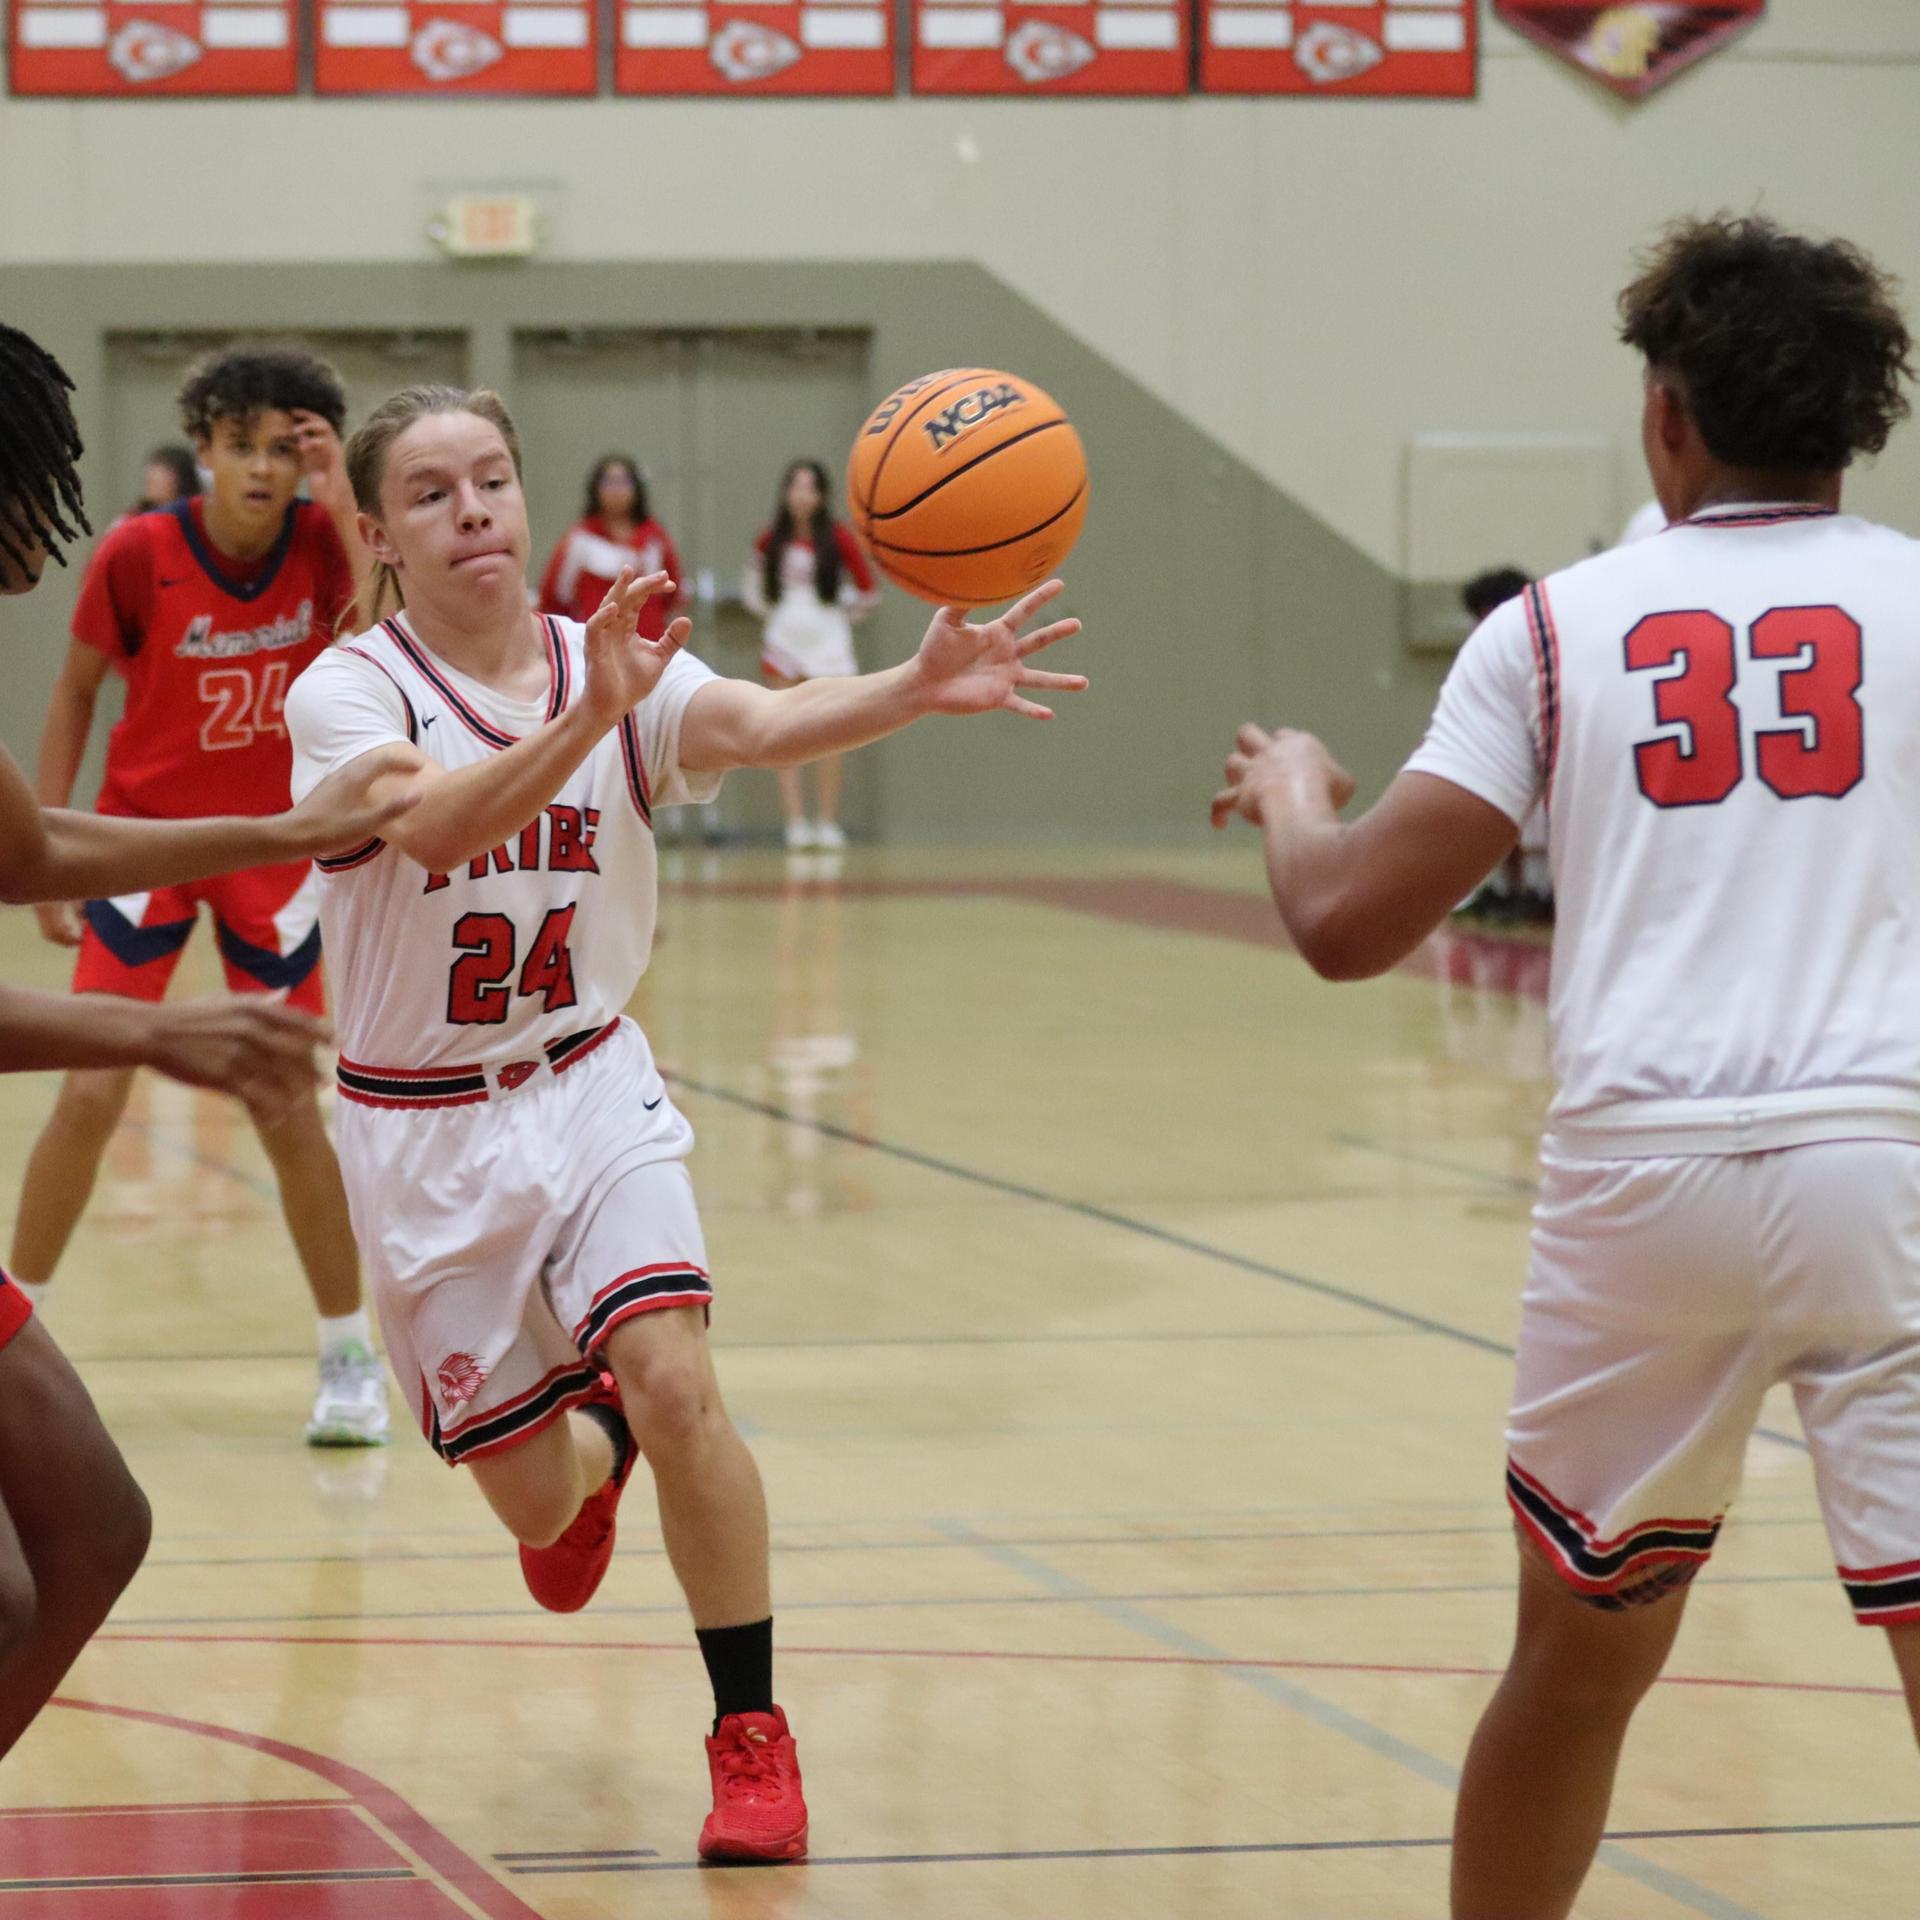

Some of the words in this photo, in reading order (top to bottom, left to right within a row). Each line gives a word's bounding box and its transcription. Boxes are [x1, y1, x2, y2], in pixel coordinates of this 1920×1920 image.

[923, 382, 1026, 453] NCAA
[199, 661, 291, 751] 24
[1622, 603, 1865, 809] 33
[446, 901, 578, 1026] 24
